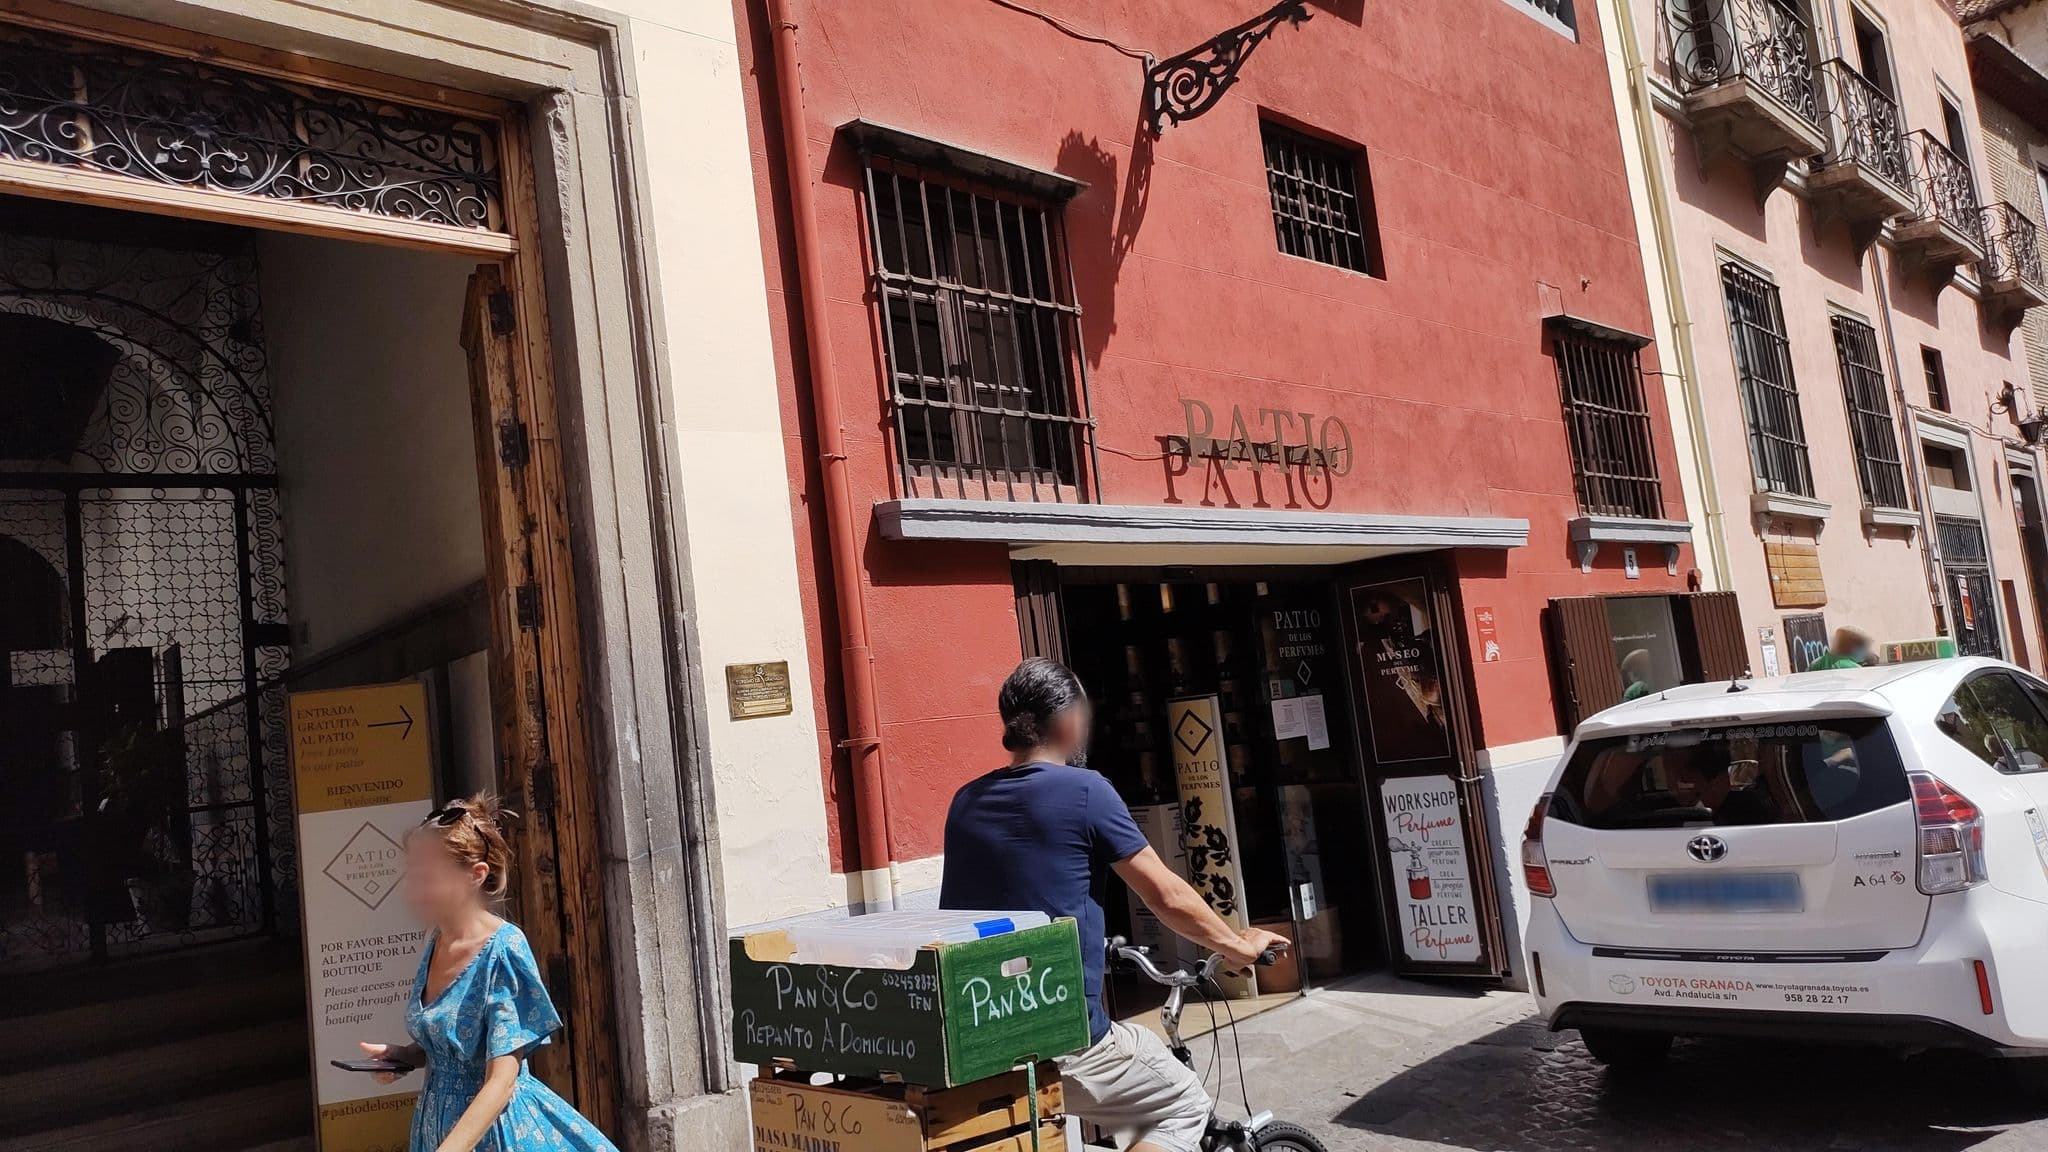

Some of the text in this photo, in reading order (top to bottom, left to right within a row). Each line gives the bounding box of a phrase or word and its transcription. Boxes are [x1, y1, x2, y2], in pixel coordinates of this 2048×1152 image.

[1178, 399, 1353, 478] PATIO
[1274, 609, 1321, 629] PATIO
[1904, 642, 1936, 657] TAXI
[297, 705, 355, 720] ENTRADA
[298, 718, 360, 733] GRATUITA
[299, 732, 354, 745] AL PATIO
[1178, 760, 1220, 774] PATIO
[327, 778, 404, 797] BIENVENIDO
[1385, 790, 1456, 814] WORKSHOP
[1393, 812, 1456, 843] Perfume
[345, 849, 397, 865] PATIO
[1854, 874, 1885, 887] A 64
[1409, 904, 1468, 927] TALLER
[321, 941, 343, 953] POR
[346, 937, 384, 950] FAVOR
[1410, 927, 1474, 960] Perfume
[322, 945, 417, 966] AL PATIO POR LA
[322, 962, 383, 979] BOUTIQUE
[324, 985, 359, 998] Please
[361, 980, 395, 993] access
[1640, 976, 1755, 992] TOYOTA GRANADA
[325, 999, 355, 1015] patio
[357, 991, 400, 1008] through
[908, 993, 931, 1011] TFN
[1654, 989, 1672, 998] Avd.
[1723, 992, 1738, 1001] s/n
[1784, 993, 1849, 1004] 958 28 22 17
[325, 1011, 374, 1027] boutique
[821, 1017, 835, 1053] A
[840, 1022, 916, 1060] DOMICILIO
[320, 1095, 419, 1121] #patiodelosper
[821, 1100, 837, 1134] &
[756, 1125, 788, 1148] MASA
